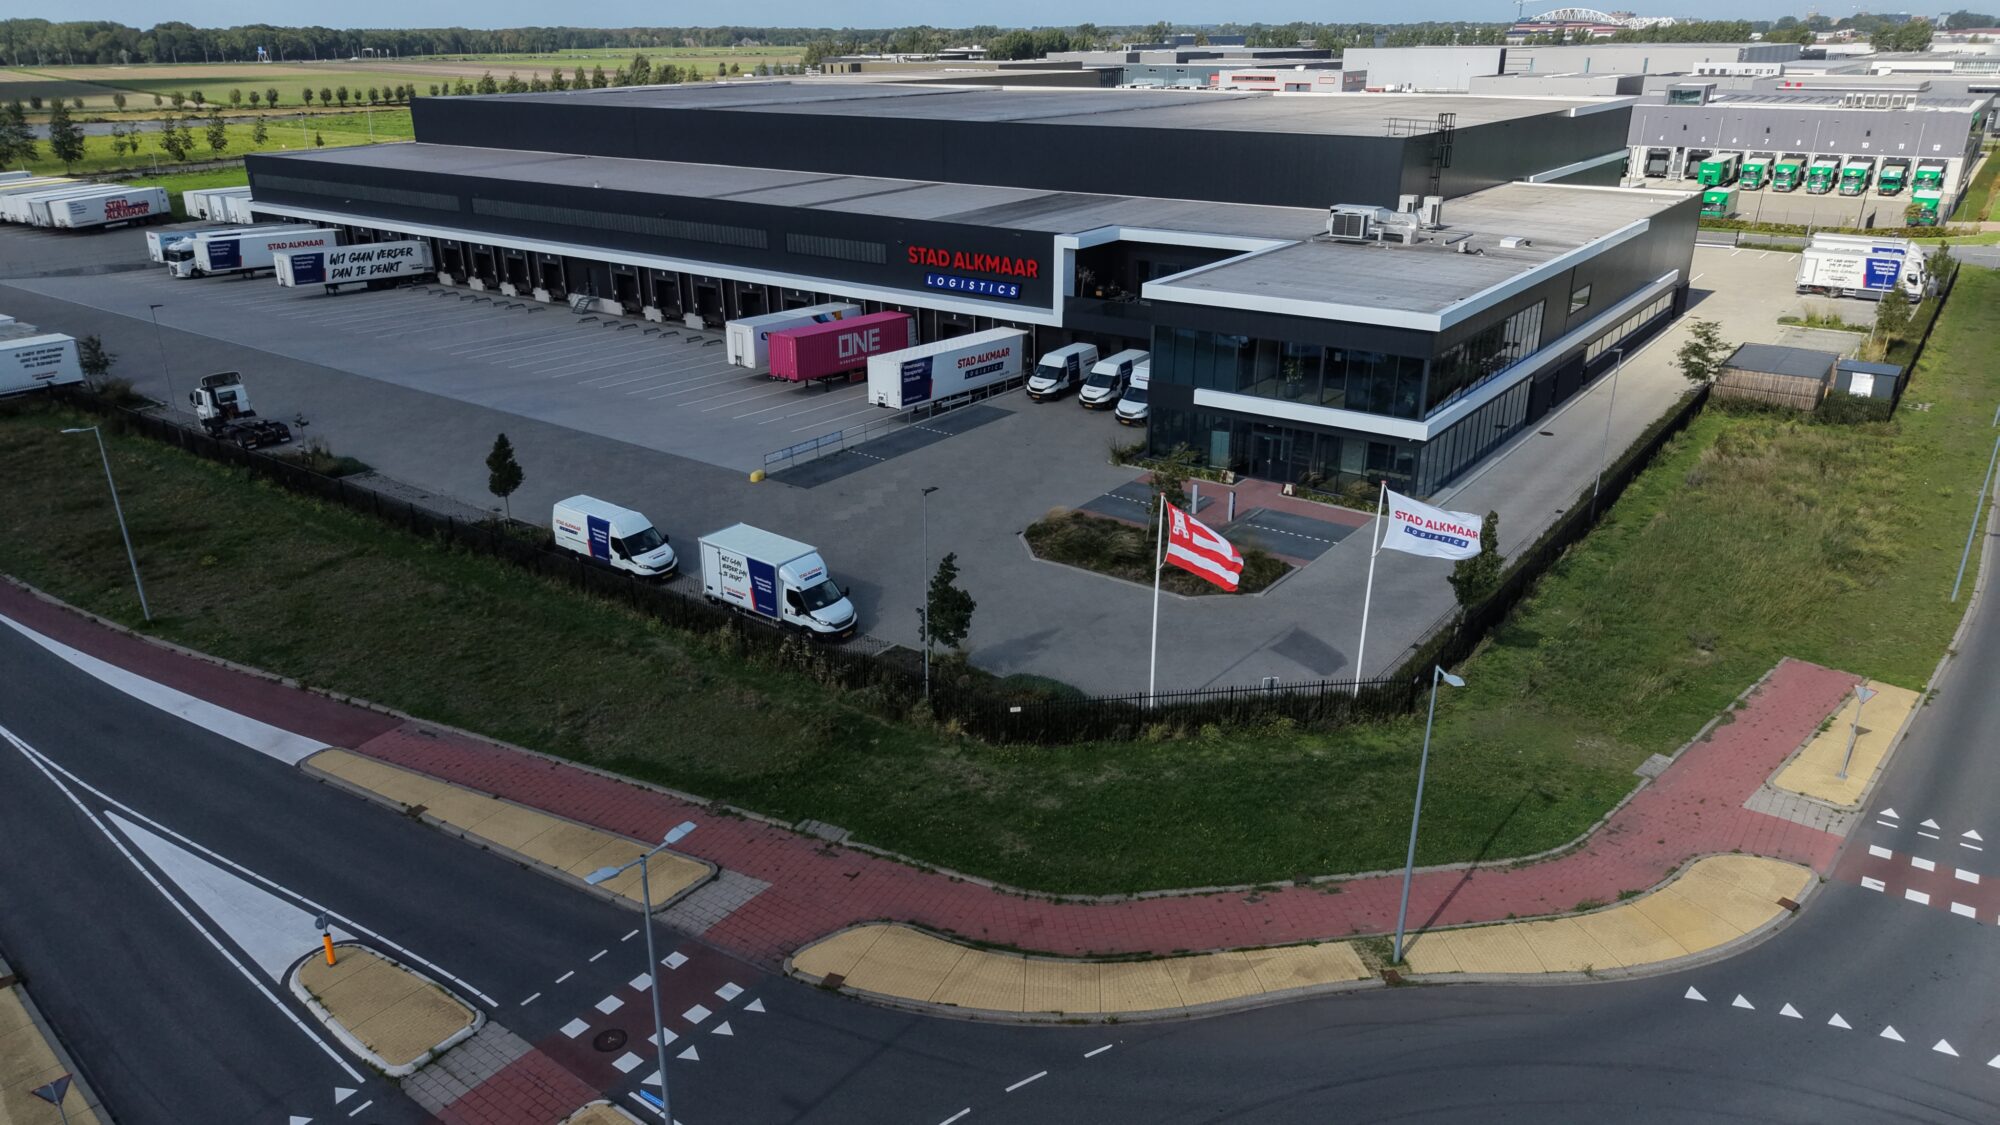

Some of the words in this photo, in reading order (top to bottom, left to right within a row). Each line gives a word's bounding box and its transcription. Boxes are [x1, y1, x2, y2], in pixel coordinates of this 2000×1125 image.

[104, 200, 128, 210] STAD
[105, 205, 150, 220] ALKMAAR
[267, 242, 287, 250] STAD
[288, 239, 324, 249] ALKMAAR
[329, 252, 346, 265] WIJ
[349, 250, 374, 263] GAAN
[376, 247, 414, 261] VERDER
[907, 246, 951, 267] STAD
[953, 252, 1038, 279] ALKMAAR
[331, 266, 353, 279] DAN
[356, 265, 367, 277] JE
[369, 261, 403, 275] DENKT
[927, 275, 1017, 296] LOGISTICS
[838, 328, 880, 358] ONE
[957, 355, 976, 369] STAD
[977, 347, 1010, 364] ALKMAAR
[1395, 510, 1423, 526] STAD
[1425, 519, 1479, 540] ALKMAAR
[1406, 527, 1467, 546] LOGISTICS
